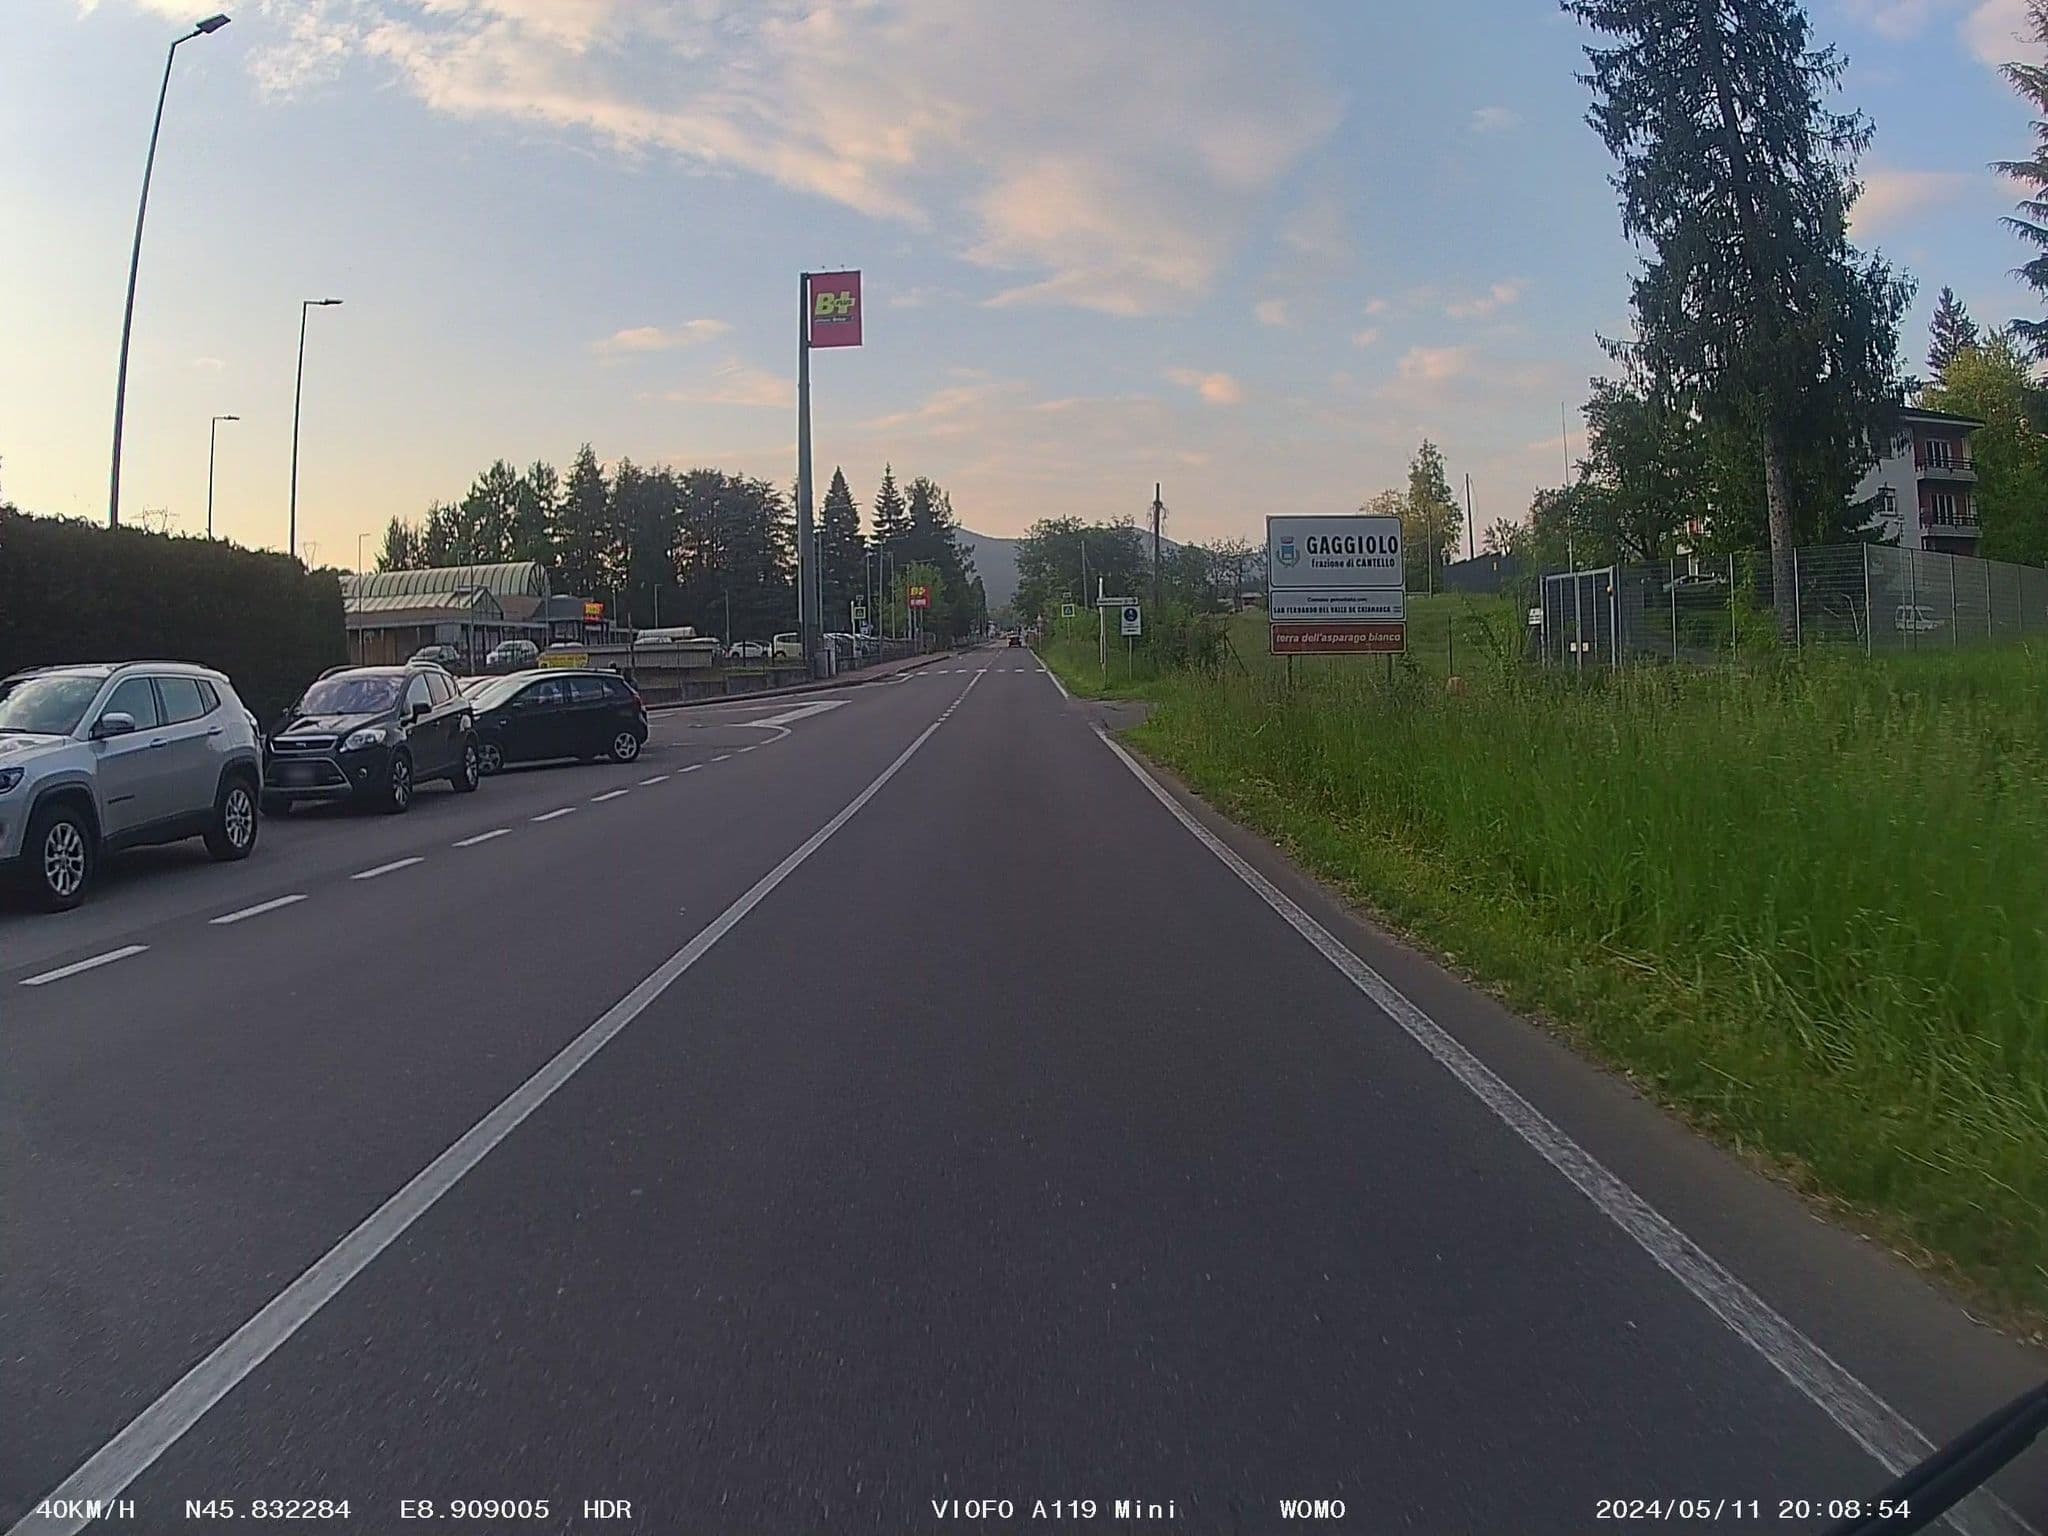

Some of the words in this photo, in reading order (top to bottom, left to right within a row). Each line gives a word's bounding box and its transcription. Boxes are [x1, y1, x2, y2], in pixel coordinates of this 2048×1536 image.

[1306, 535, 1399, 554] GAGGIOLO
[1312, 558, 1345, 568] frazione
[1346, 558, 1354, 568] di
[1356, 558, 1395, 568] CANTELLO
[1276, 633, 1299, 643] terra
[1301, 632, 1366, 644] dell'asparago
[1368, 632, 1401, 642] bianco
